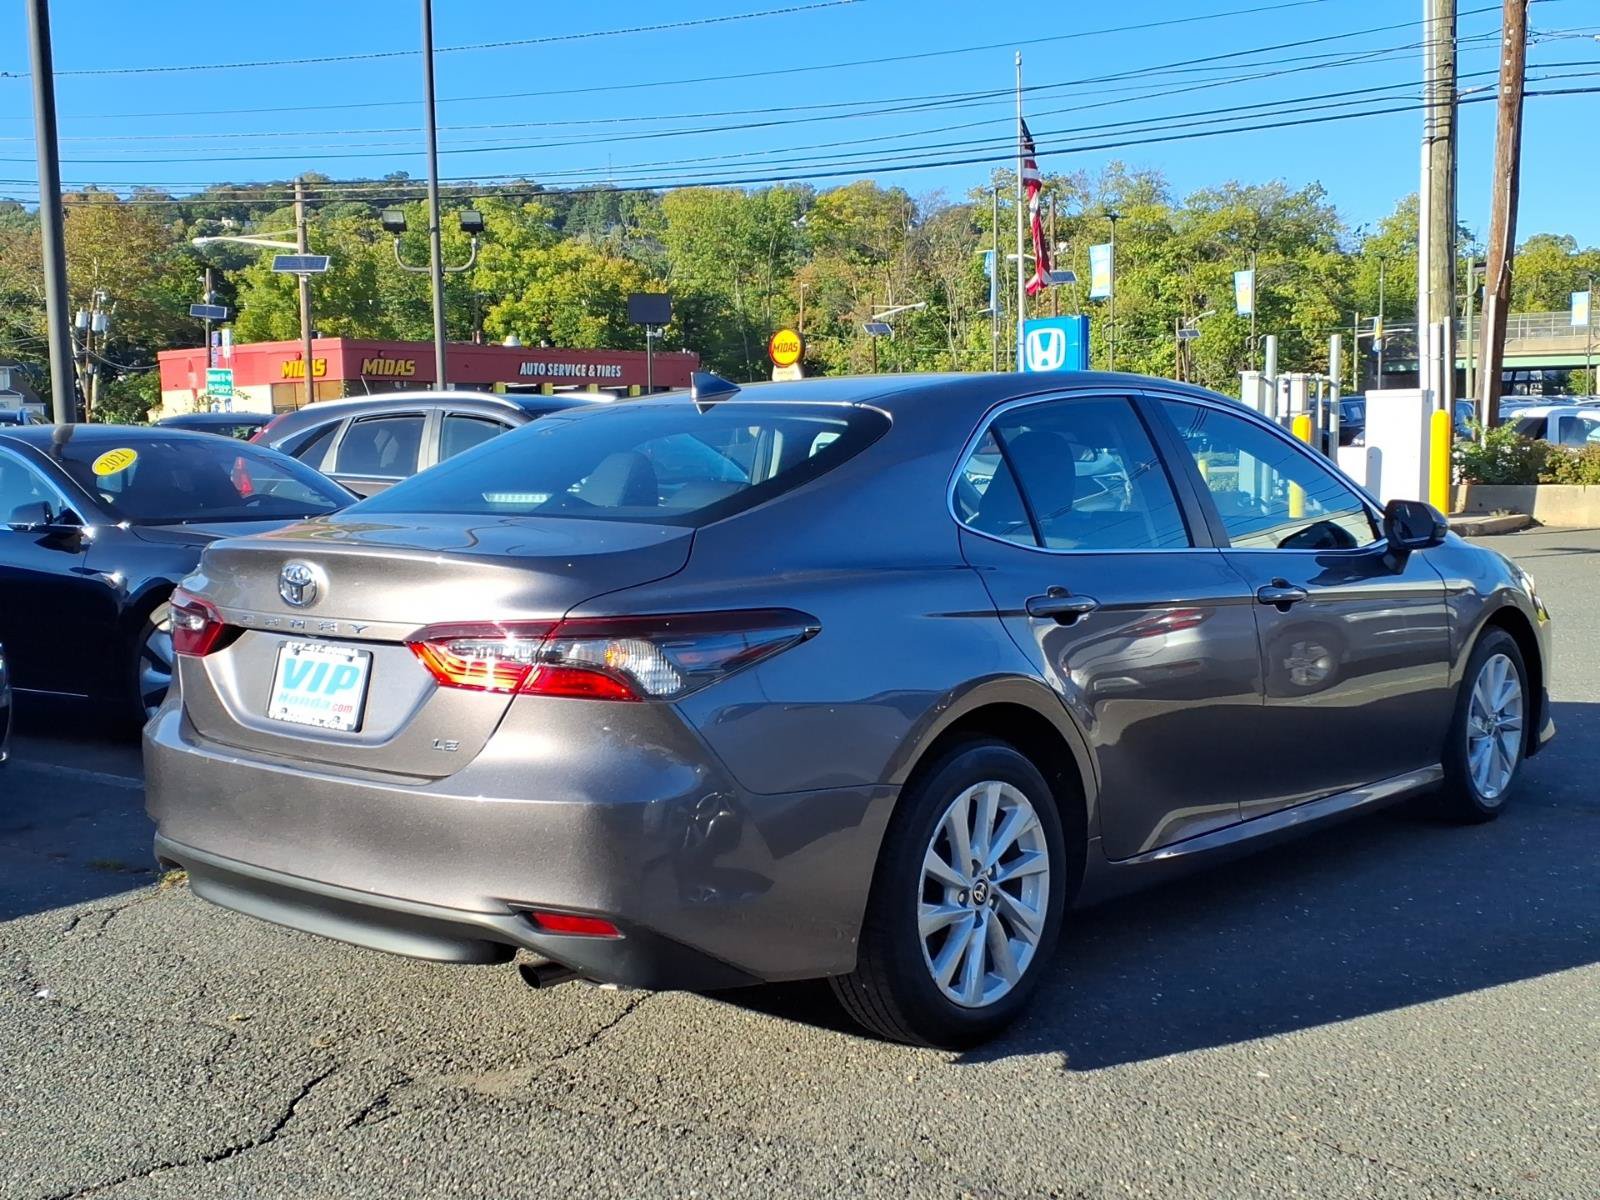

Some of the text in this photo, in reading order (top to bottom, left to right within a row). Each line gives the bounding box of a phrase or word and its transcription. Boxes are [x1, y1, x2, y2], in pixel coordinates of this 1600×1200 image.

[773, 342, 798, 353] MIDAS
[361, 358, 416, 376] MIDAS
[520, 362, 622, 377] AUTO SERVICE & TIRES
[100, 451, 129, 471] 2021
[283, 658, 360, 695] VIP
[432, 738, 460, 752] LE
